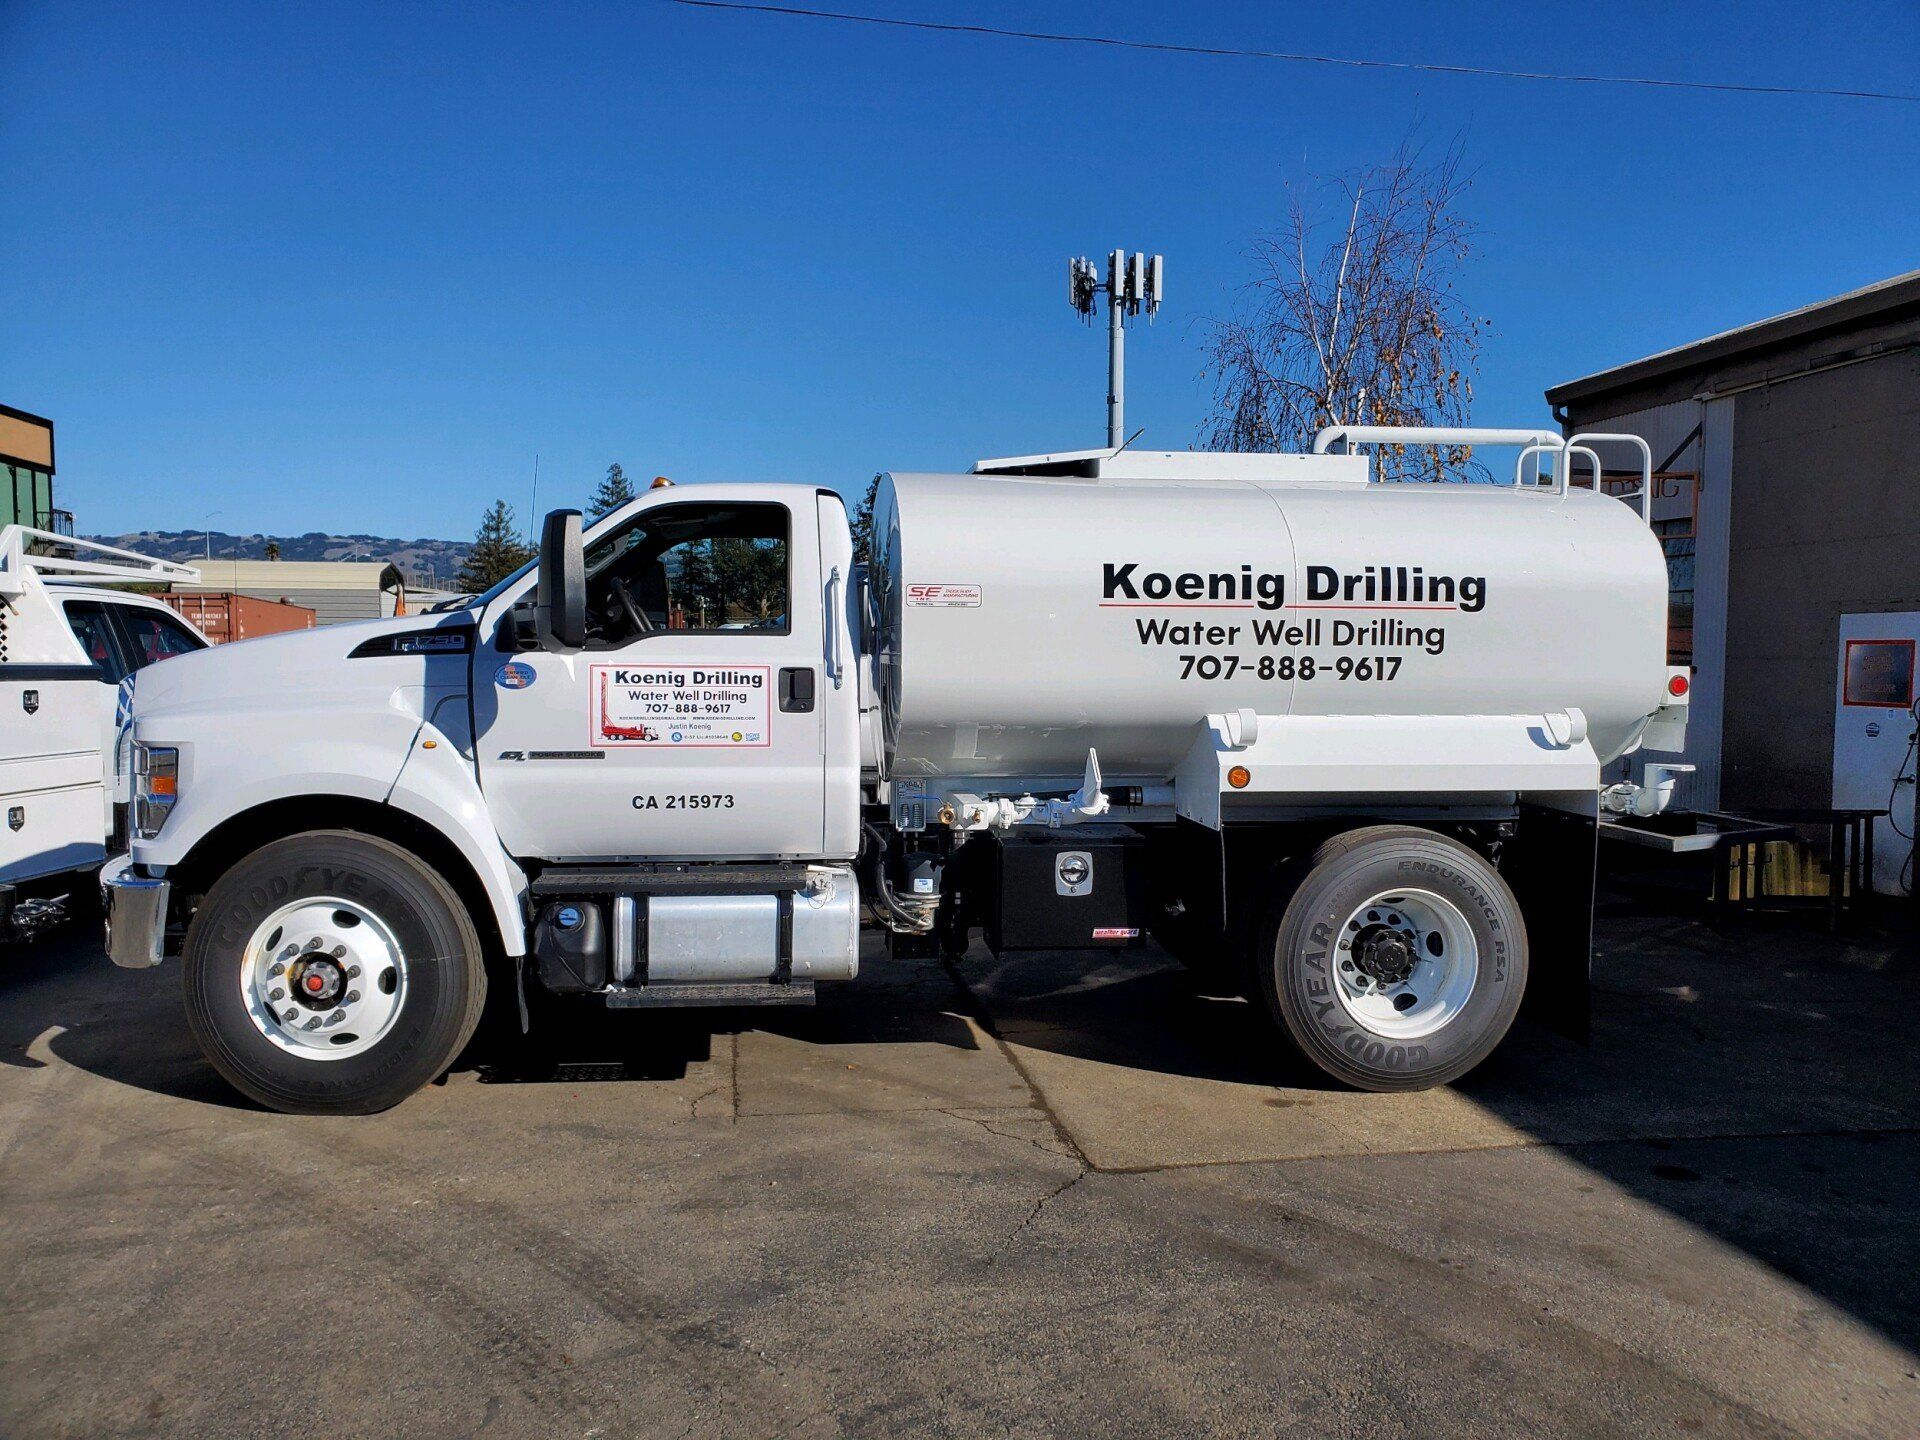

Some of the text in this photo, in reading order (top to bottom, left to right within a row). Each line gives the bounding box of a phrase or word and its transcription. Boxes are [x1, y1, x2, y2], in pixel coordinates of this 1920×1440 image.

[1102, 563, 1487, 613] Koenig Drilling
[1136, 619, 1446, 655] Water Well Drilling
[1179, 655, 1402, 681] 707-888-9617
[615, 670, 763, 688] Koenig Drilling
[628, 690, 747, 703] Water Well Drilling
[645, 703, 731, 714] 707-888-9617
[668, 722, 712, 731] Justin Koenig
[632, 794, 734, 809] CA 215973
[1398, 860, 1506, 983] ENDURANCE RSA
